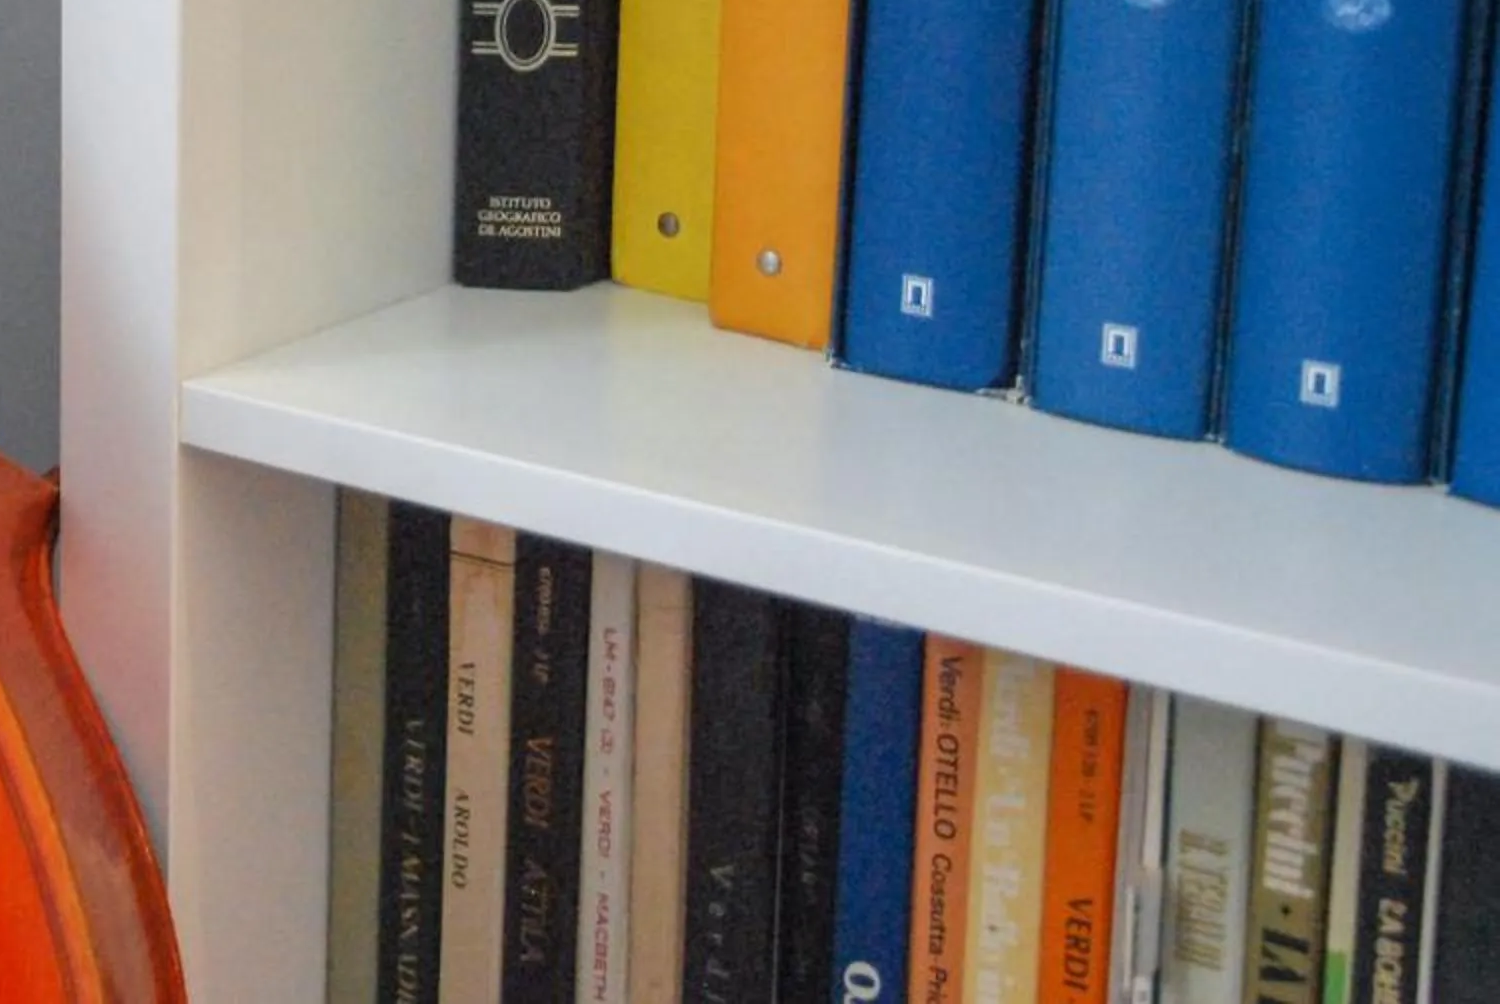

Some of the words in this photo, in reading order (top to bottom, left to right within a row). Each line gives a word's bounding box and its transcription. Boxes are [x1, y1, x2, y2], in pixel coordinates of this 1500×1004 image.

[477, 209, 562, 224] GEOGRAFICO
[477, 223, 495, 236] DE
[499, 225, 562, 238] AGOSTINI
[489, 196, 552, 210] ISTITUTO
[454, 662, 475, 737] VERDI
[522, 735, 552, 833] VERDI
[932, 733, 959, 841] OTELLO
[1381, 779, 1419, 876] Puccini
[448, 787, 469, 890] AROLDO
[518, 856, 550, 964] ATTILA
[592, 892, 610, 1002] MACBETH
[1060, 896, 1094, 994] VERDI
